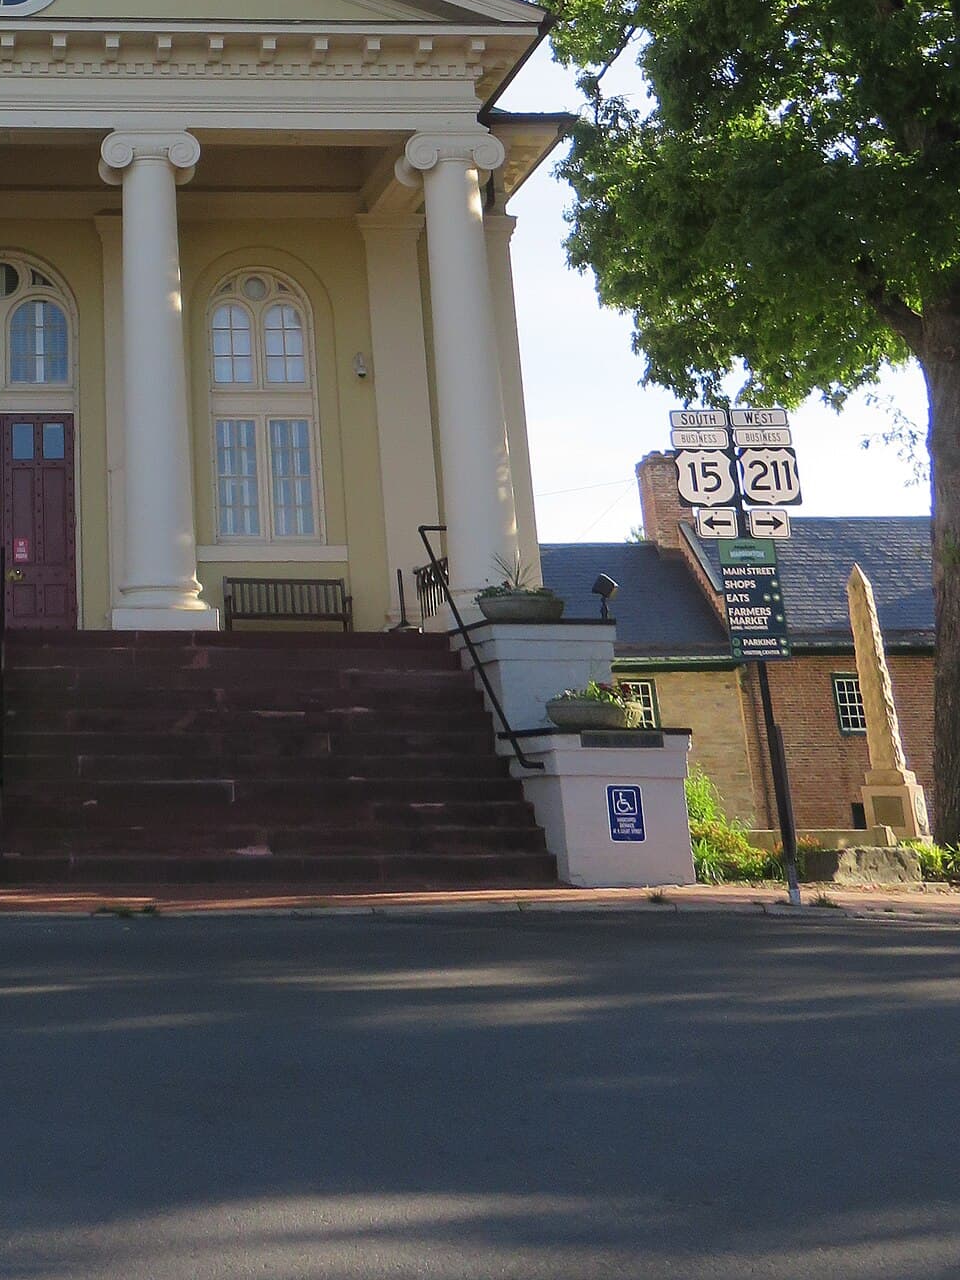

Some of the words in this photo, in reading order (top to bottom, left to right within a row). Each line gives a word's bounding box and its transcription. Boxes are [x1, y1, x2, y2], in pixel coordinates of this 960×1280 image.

[680, 413, 717, 425] SOUTH
[744, 412, 774, 424] WEST
[681, 434, 717, 443] BUSINESS
[745, 432, 781, 442] BUSINESS
[687, 461, 722, 493] 15
[748, 460, 793, 491] 211
[723, 567, 746, 575] MAIN
[747, 567, 776, 575] STREET
[724, 580, 757, 589] SHOPS
[726, 593, 750, 603] EATS
[728, 607, 772, 616] FARMERS
[729, 616, 769, 625] MARKET
[742, 638, 777, 646] PARKING
